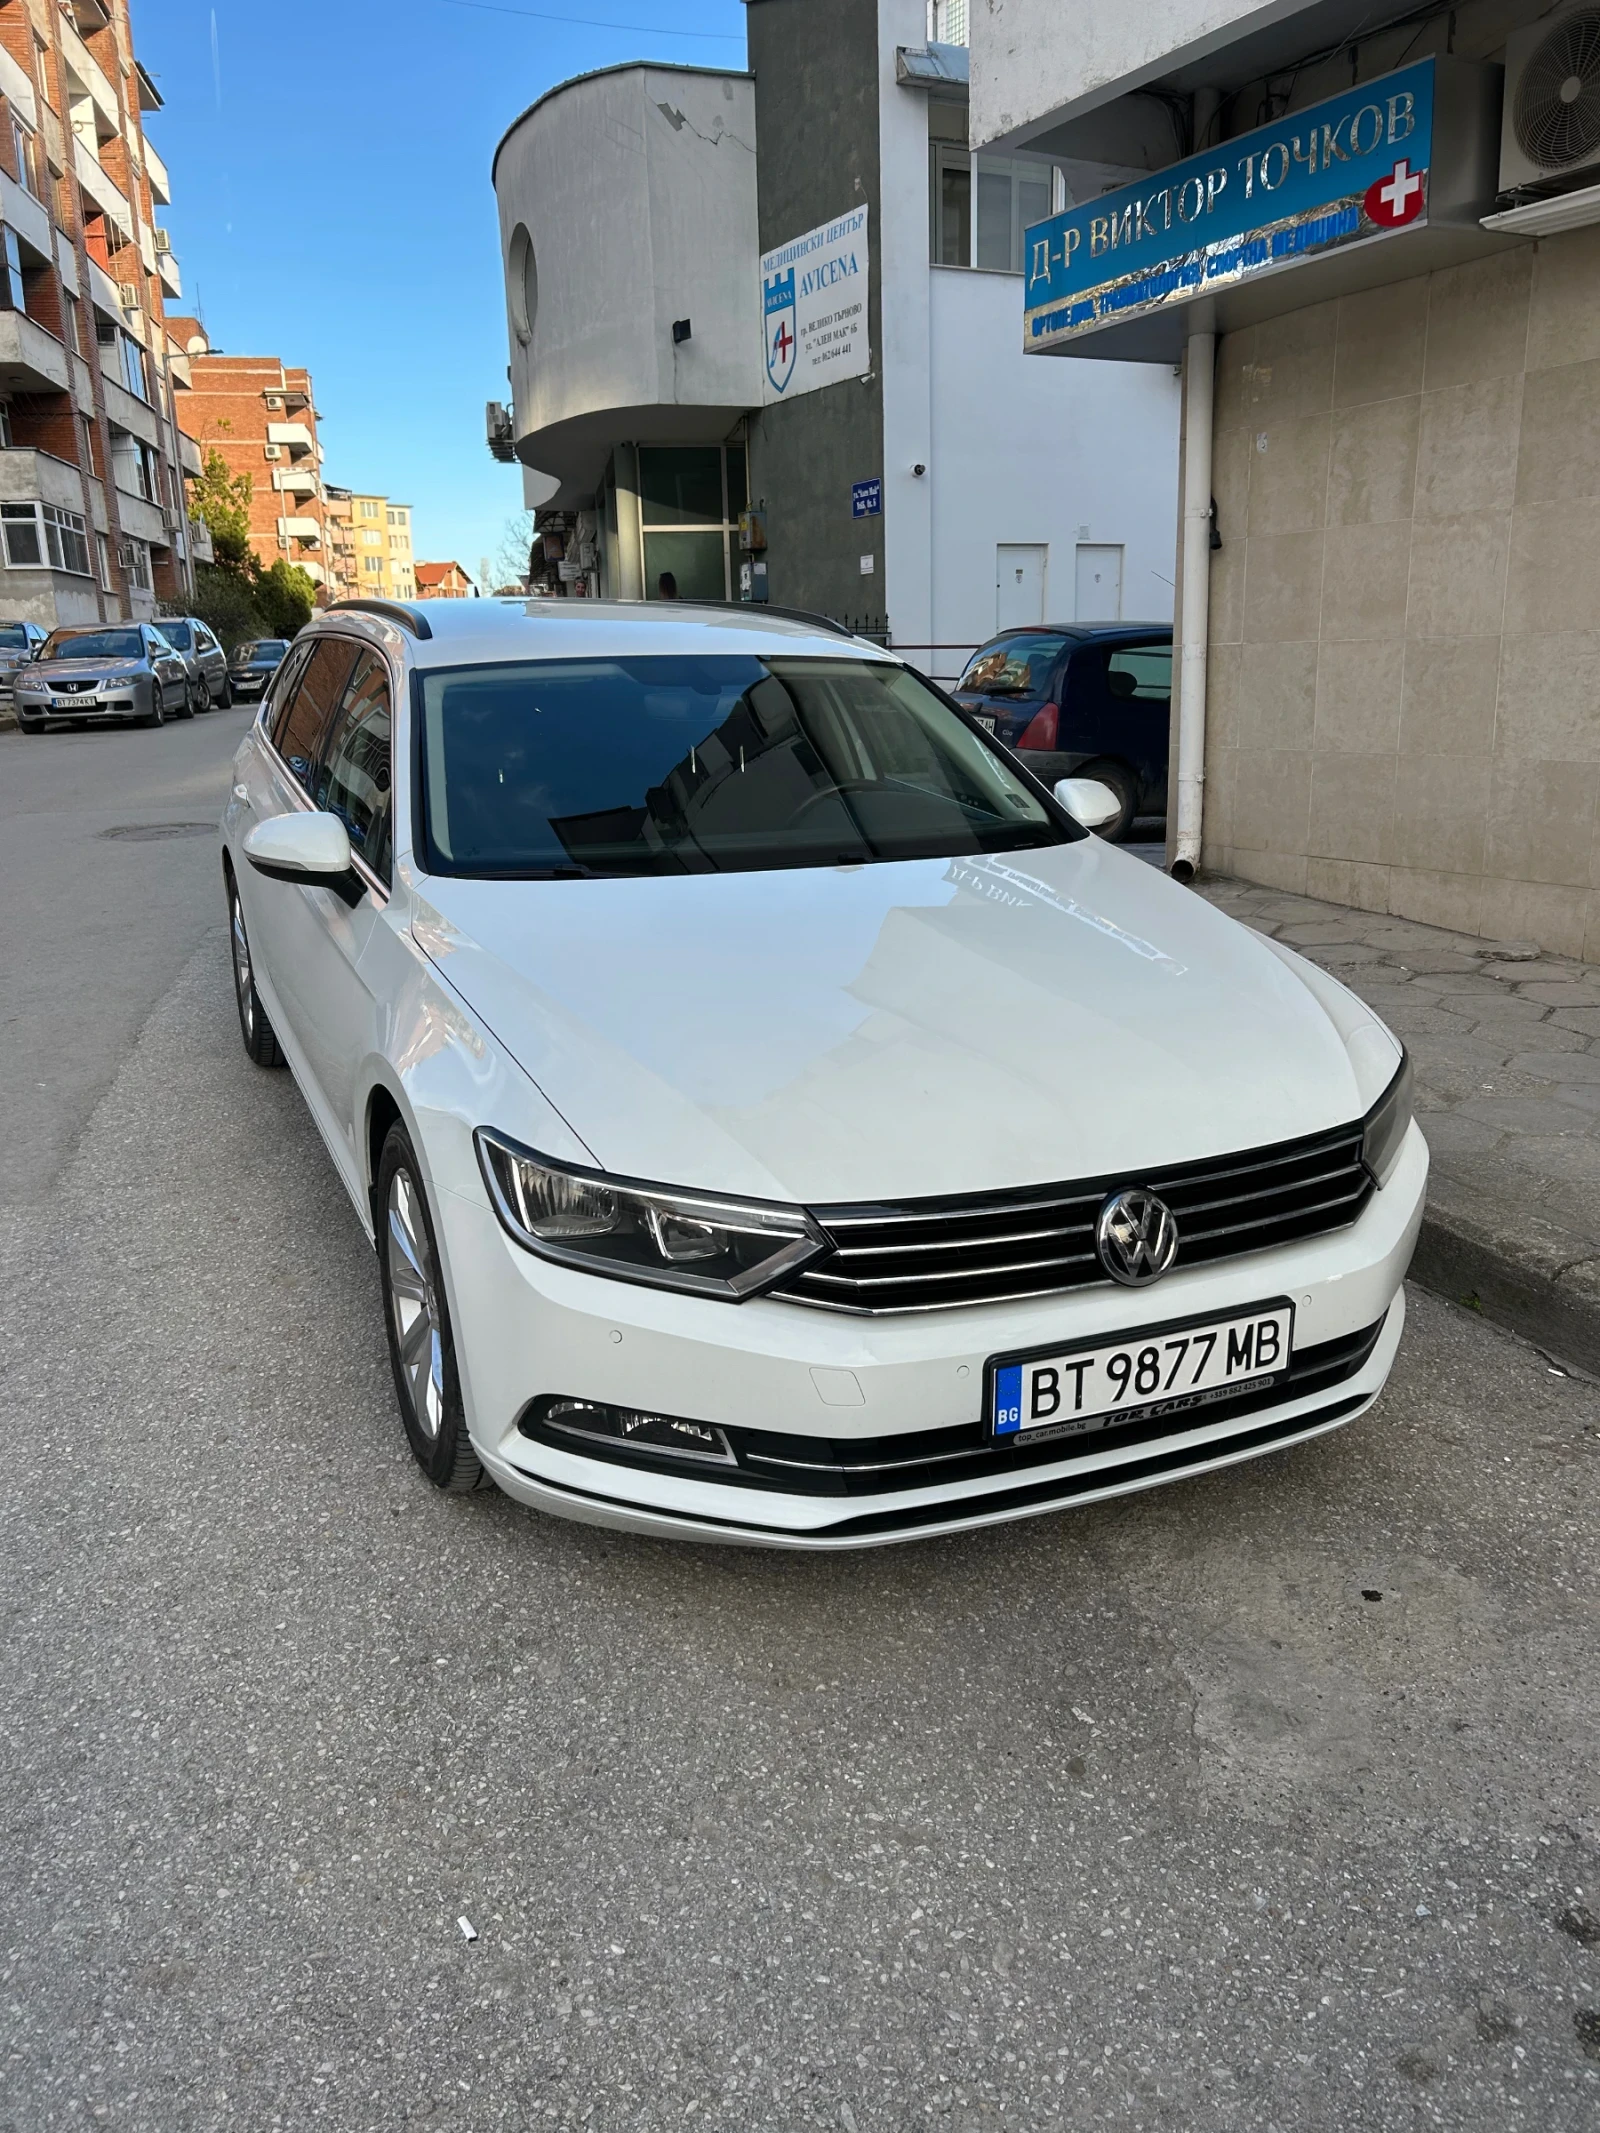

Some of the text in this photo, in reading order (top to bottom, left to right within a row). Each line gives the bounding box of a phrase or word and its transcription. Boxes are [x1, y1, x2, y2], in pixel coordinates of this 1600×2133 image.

[1029, 91, 1416, 291] Д-Р ВИКТОР ТОЧКОВ
[763, 213, 864, 273] МЕДИЦИНСКИ ЦЕНТЪР
[800, 251, 859, 299] AVICENA
[808, 314, 833, 333] ВЕЛИКО
[833, 302, 862, 322] ТЪРНОВО
[1031, 1319, 1280, 1420] BT 9877 MB
[1210, 1390, 1227, 1400] +359
[1229, 1386, 1242, 1396] 882
[1258, 1377, 1271, 1388] 901
[998, 1406, 1019, 1425] BG
[1018, 1422, 1087, 1442] top_car.mobile.bg
